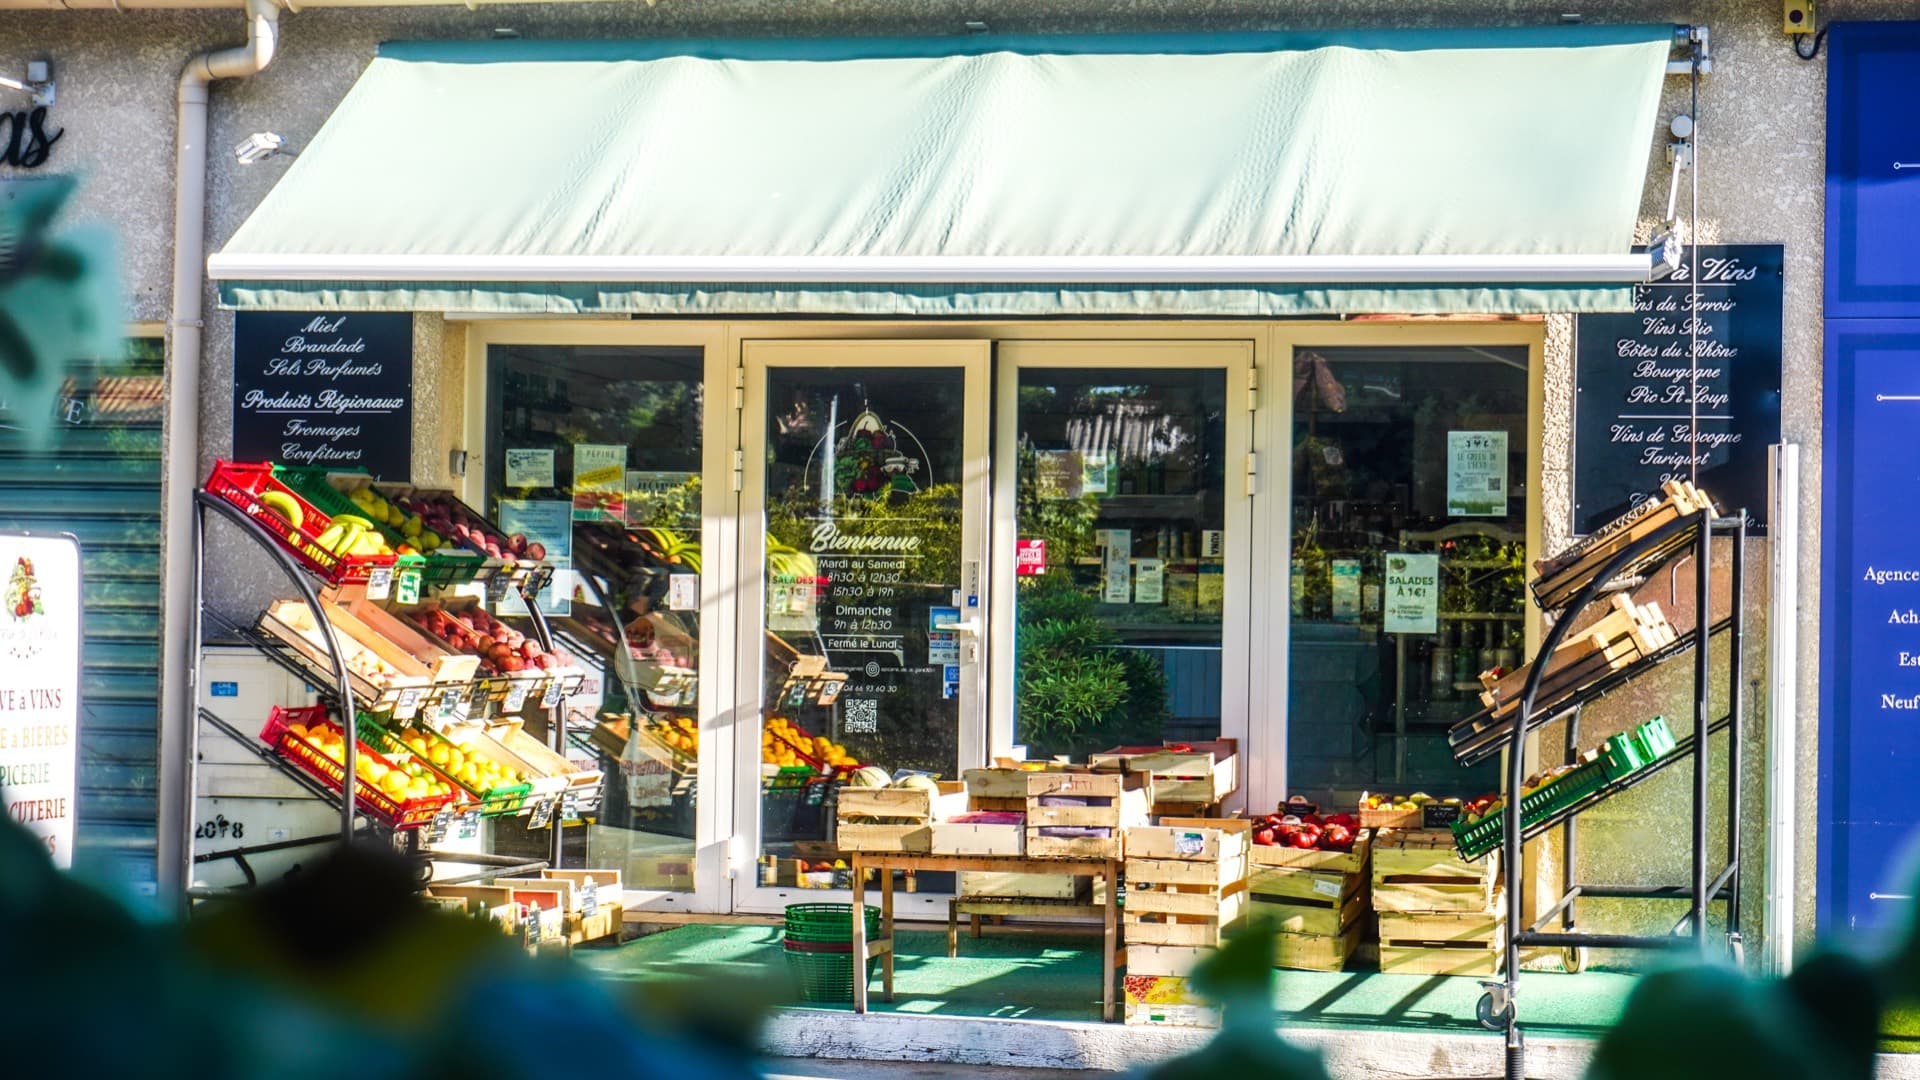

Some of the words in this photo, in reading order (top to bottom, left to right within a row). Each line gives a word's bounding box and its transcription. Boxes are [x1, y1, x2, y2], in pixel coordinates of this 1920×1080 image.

[1670, 263, 1690, 281] à
[1702, 257, 1758, 281] Vins
[1634, 293, 1652, 311] ins
[1656, 295, 1676, 311] du
[1681, 293, 1736, 311] Terroir
[300, 316, 346, 333] Miel
[1643, 317, 1676, 335] Vins
[1679, 318, 1713, 335] Bio
[281, 335, 366, 353] Brandade
[1616, 339, 1658, 358] Côtes
[1661, 341, 1681, 357] du
[1685, 340, 1738, 358] Rhône
[263, 358, 302, 376] Sels
[303, 358, 383, 381] Parfumés
[1633, 360, 1721, 384] Bourgogne
[241, 389, 312, 409] Produits
[314, 389, 404, 415] Régionaux
[1627, 385, 1658, 404] Pic
[1660, 385, 1685, 404] St
[1686, 385, 1729, 409] Loup
[282, 419, 360, 442] Fromages
[1610, 424, 1644, 443] Vins
[1646, 426, 1665, 443] de
[1670, 425, 1742, 448] Gascogne
[281, 442, 363, 465] Confitures
[1640, 447, 1711, 471] Tariquet
[810, 522, 922, 552] Bienvenue
[819, 559, 848, 569] Mardi
[851, 561, 865, 569] au
[867, 559, 906, 569] Samedi
[827, 572, 855, 583] 8h30
[858, 572, 866, 583] à
[870, 573, 900, 584] 12h30
[1389, 576, 1434, 585] SALADES
[1864, 566, 1920, 584] Agence
[833, 586, 863, 598] 15h30
[867, 586, 875, 597] à
[878, 587, 894, 598] 19h
[1397, 585, 1405, 597] À
[835, 605, 892, 616] Dimanche
[1888, 609, 1920, 624] Ach
[834, 620, 847, 631] 9h
[850, 618, 858, 630] à
[862, 620, 893, 631] 12h30
[828, 638, 857, 649] Fermé
[860, 639, 869, 649] le
[872, 639, 897, 649] Lundi
[866, 684, 875, 692] 93
[887, 684, 898, 692] 30
[30, 688, 62, 709] VINS
[1881, 694, 1920, 710] Neuf
